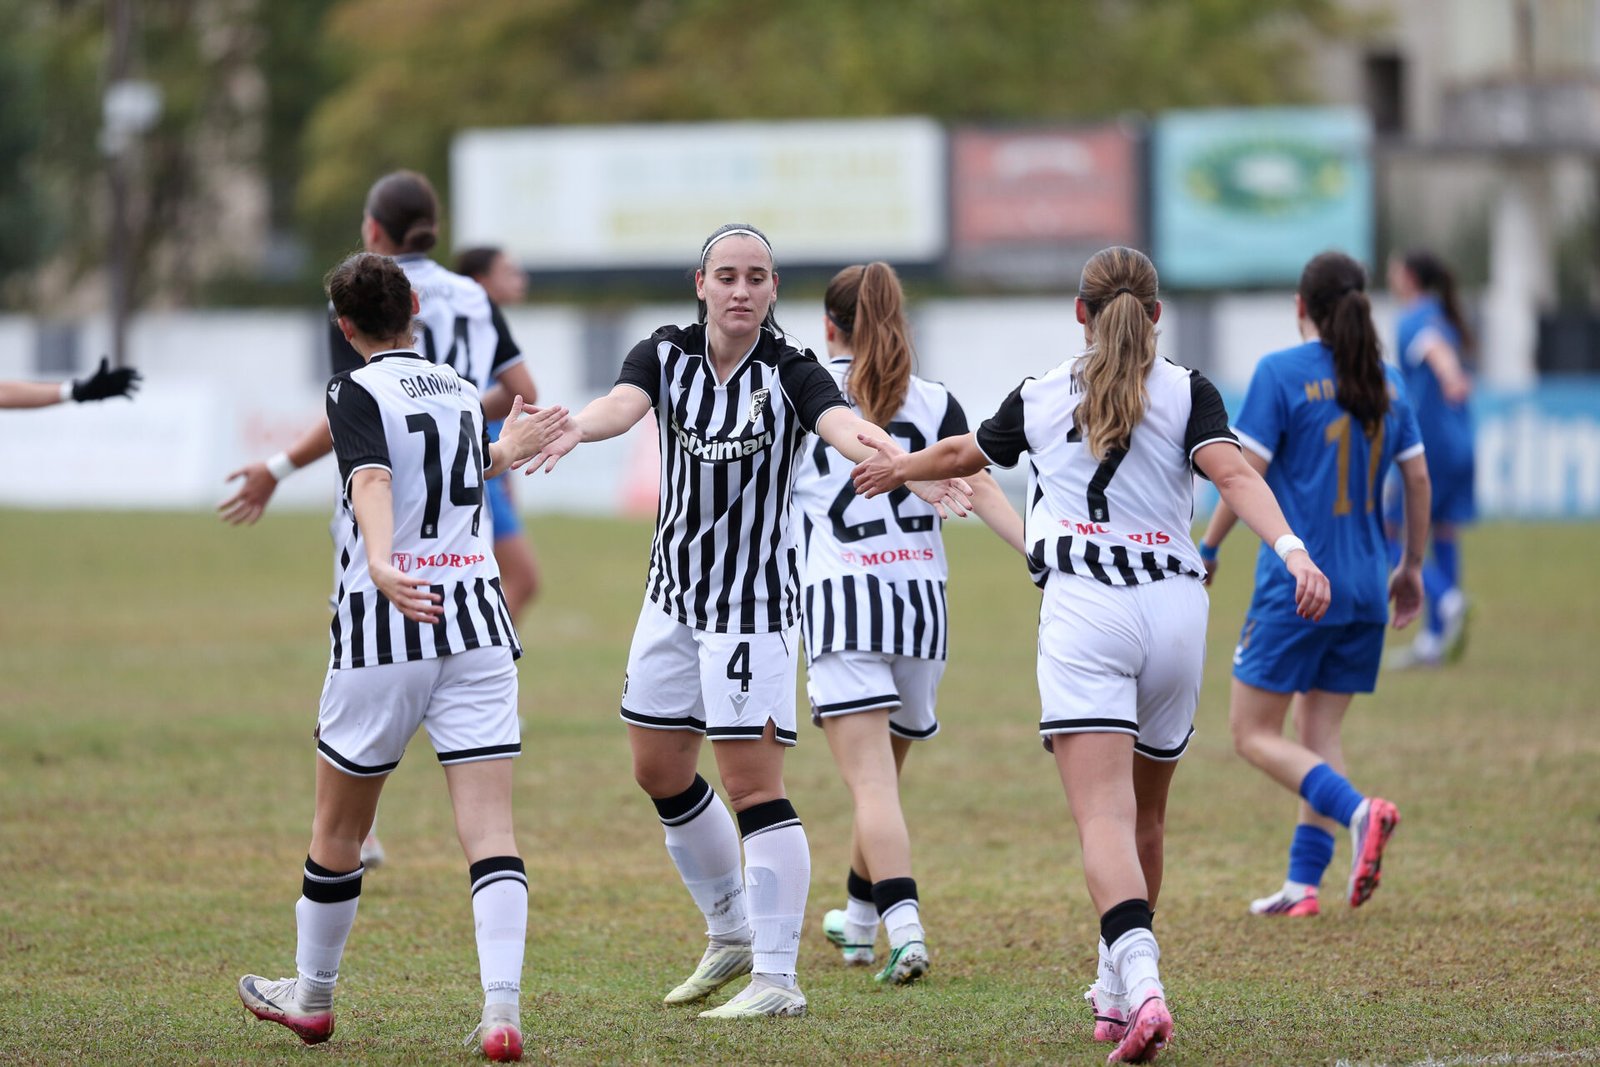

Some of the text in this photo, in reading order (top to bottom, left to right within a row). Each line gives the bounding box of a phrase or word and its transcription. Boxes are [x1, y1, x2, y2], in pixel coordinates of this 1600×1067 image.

[405, 410, 484, 539] 14
[671, 412, 773, 460] Soiximan
[1066, 406, 1132, 523] 7
[812, 421, 934, 544] 22
[1075, 522, 1171, 546] MORIS
[726, 641, 753, 693] 4
